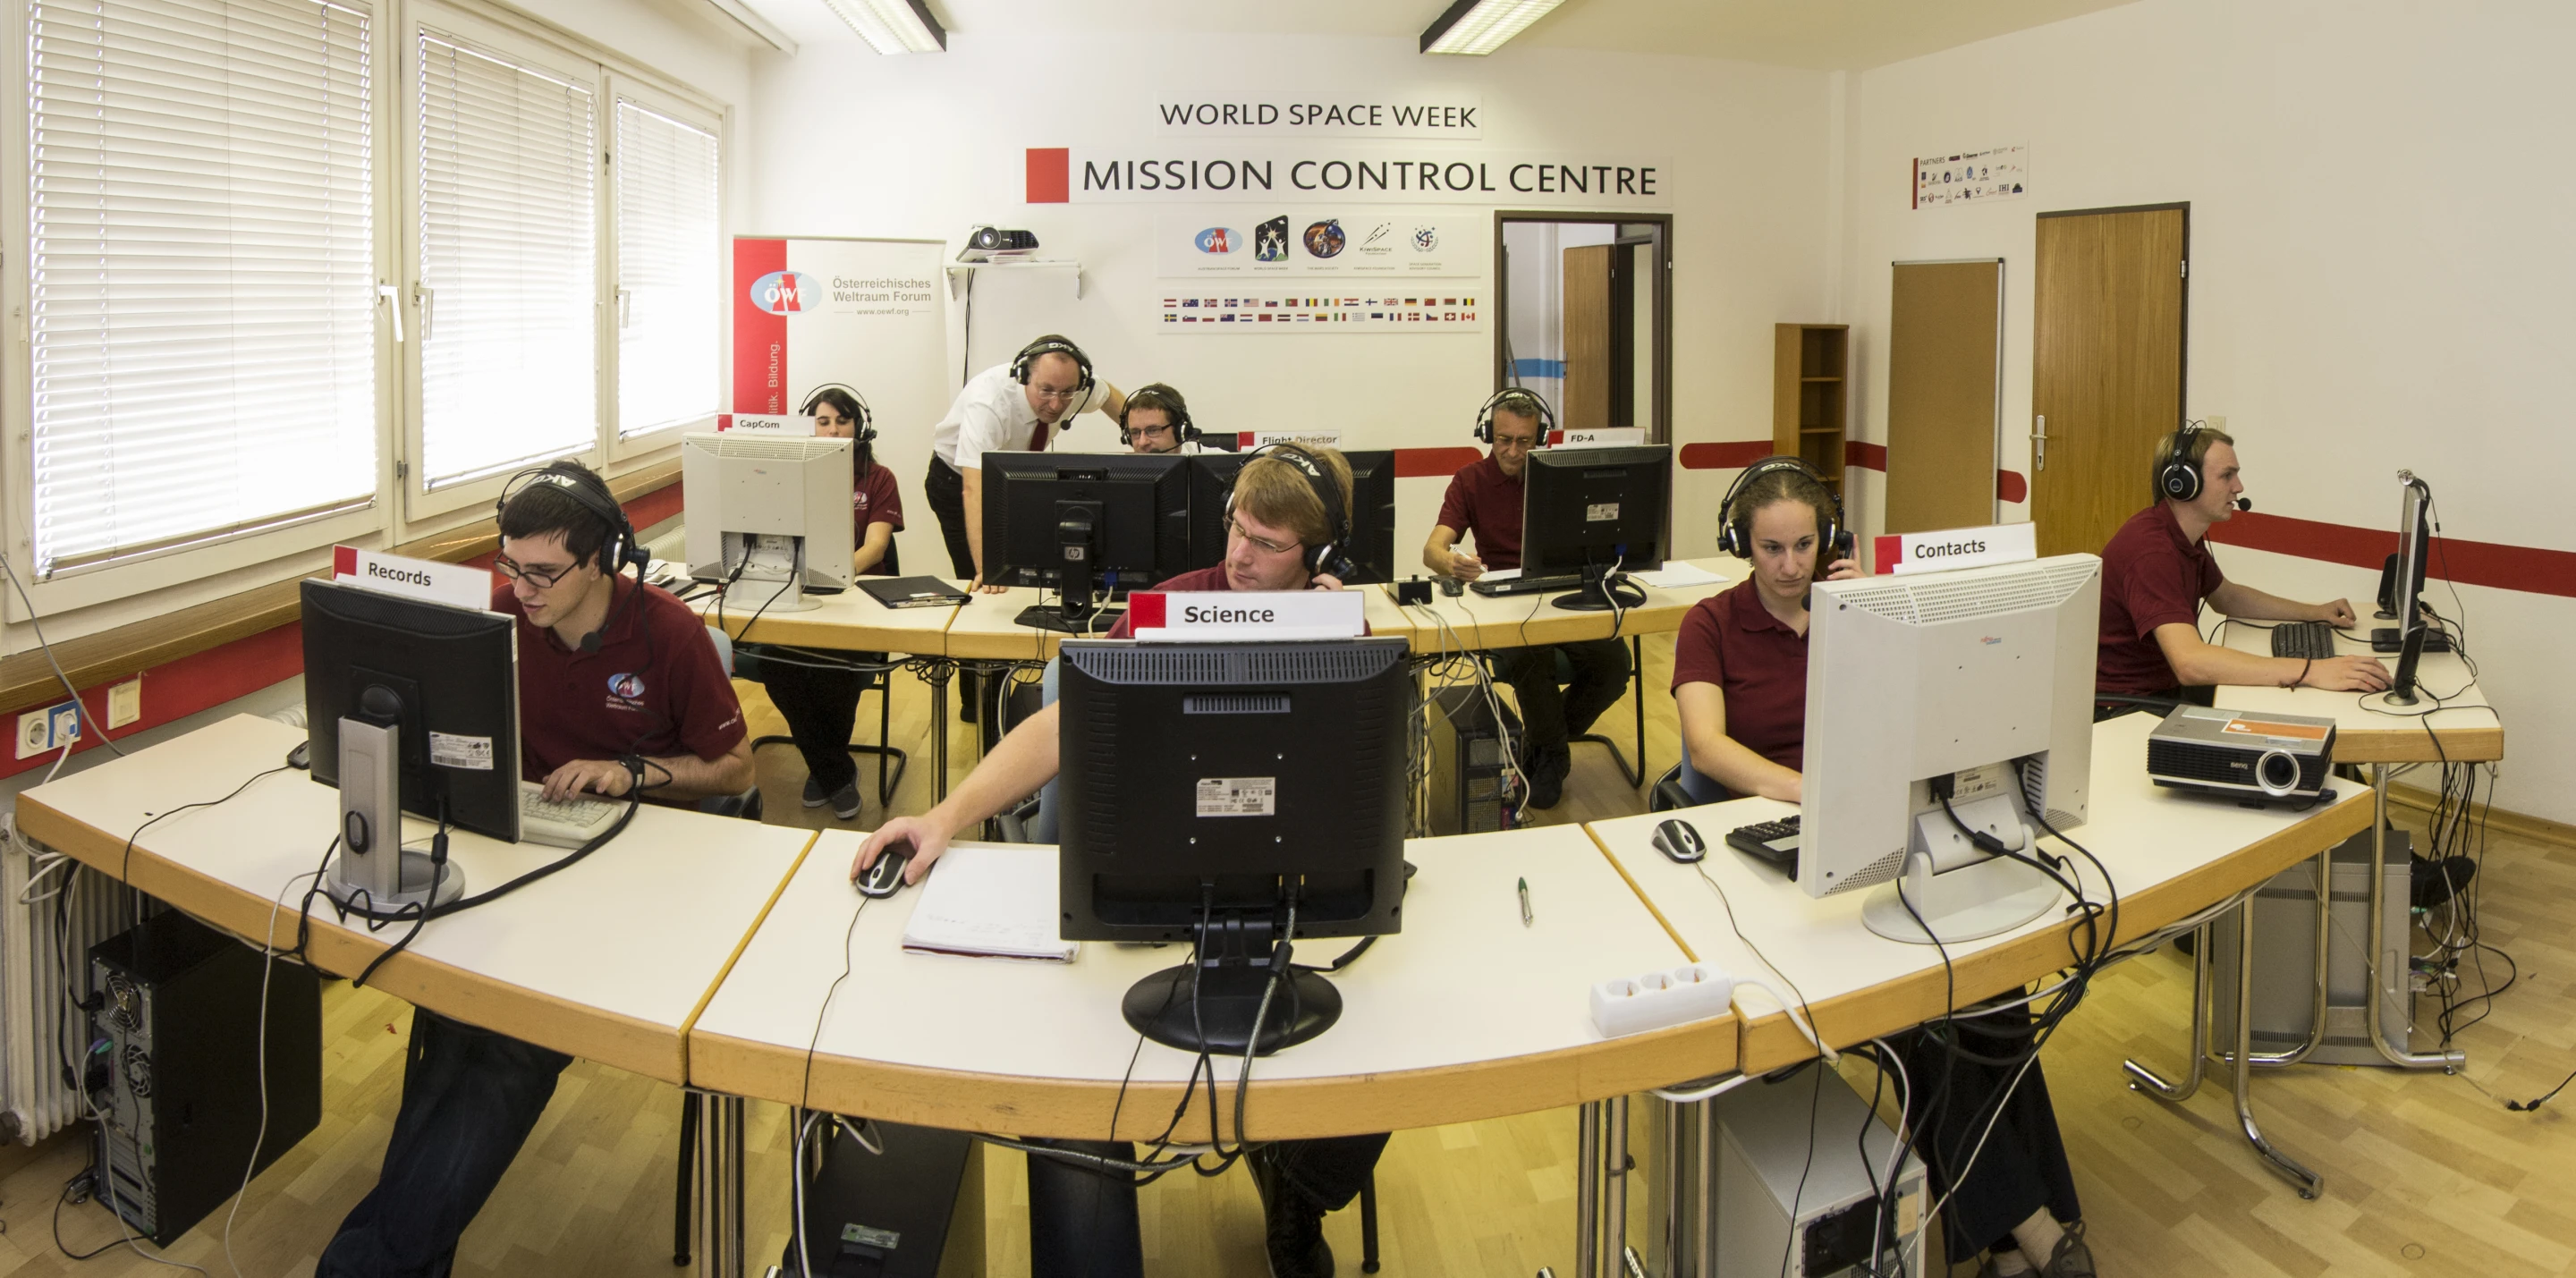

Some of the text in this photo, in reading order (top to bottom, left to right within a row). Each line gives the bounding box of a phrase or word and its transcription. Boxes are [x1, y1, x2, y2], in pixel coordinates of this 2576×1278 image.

[1160, 104, 1478, 128] WORLD SPACE WEEK
[1919, 157, 1945, 166] PARTNERS
[1083, 159, 1657, 195] MISSION CONTROL CENTRE
[1204, 234, 1233, 251] ÖWF
[833, 275, 931, 289] Österreichisches
[764, 284, 809, 306] ÖWF
[833, 292, 931, 302] Weltraum Forum
[856, 308, 910, 317] www.oewf.org
[768, 340, 781, 415] litik. Bildung.
[740, 419, 780, 429] CapCom
[1295, 435, 1338, 444] Director
[1571, 434, 1595, 443] FD-A
[1915, 539, 1986, 559] Contacts
[369, 562, 431, 587] Records
[1184, 605, 1275, 623] Science
